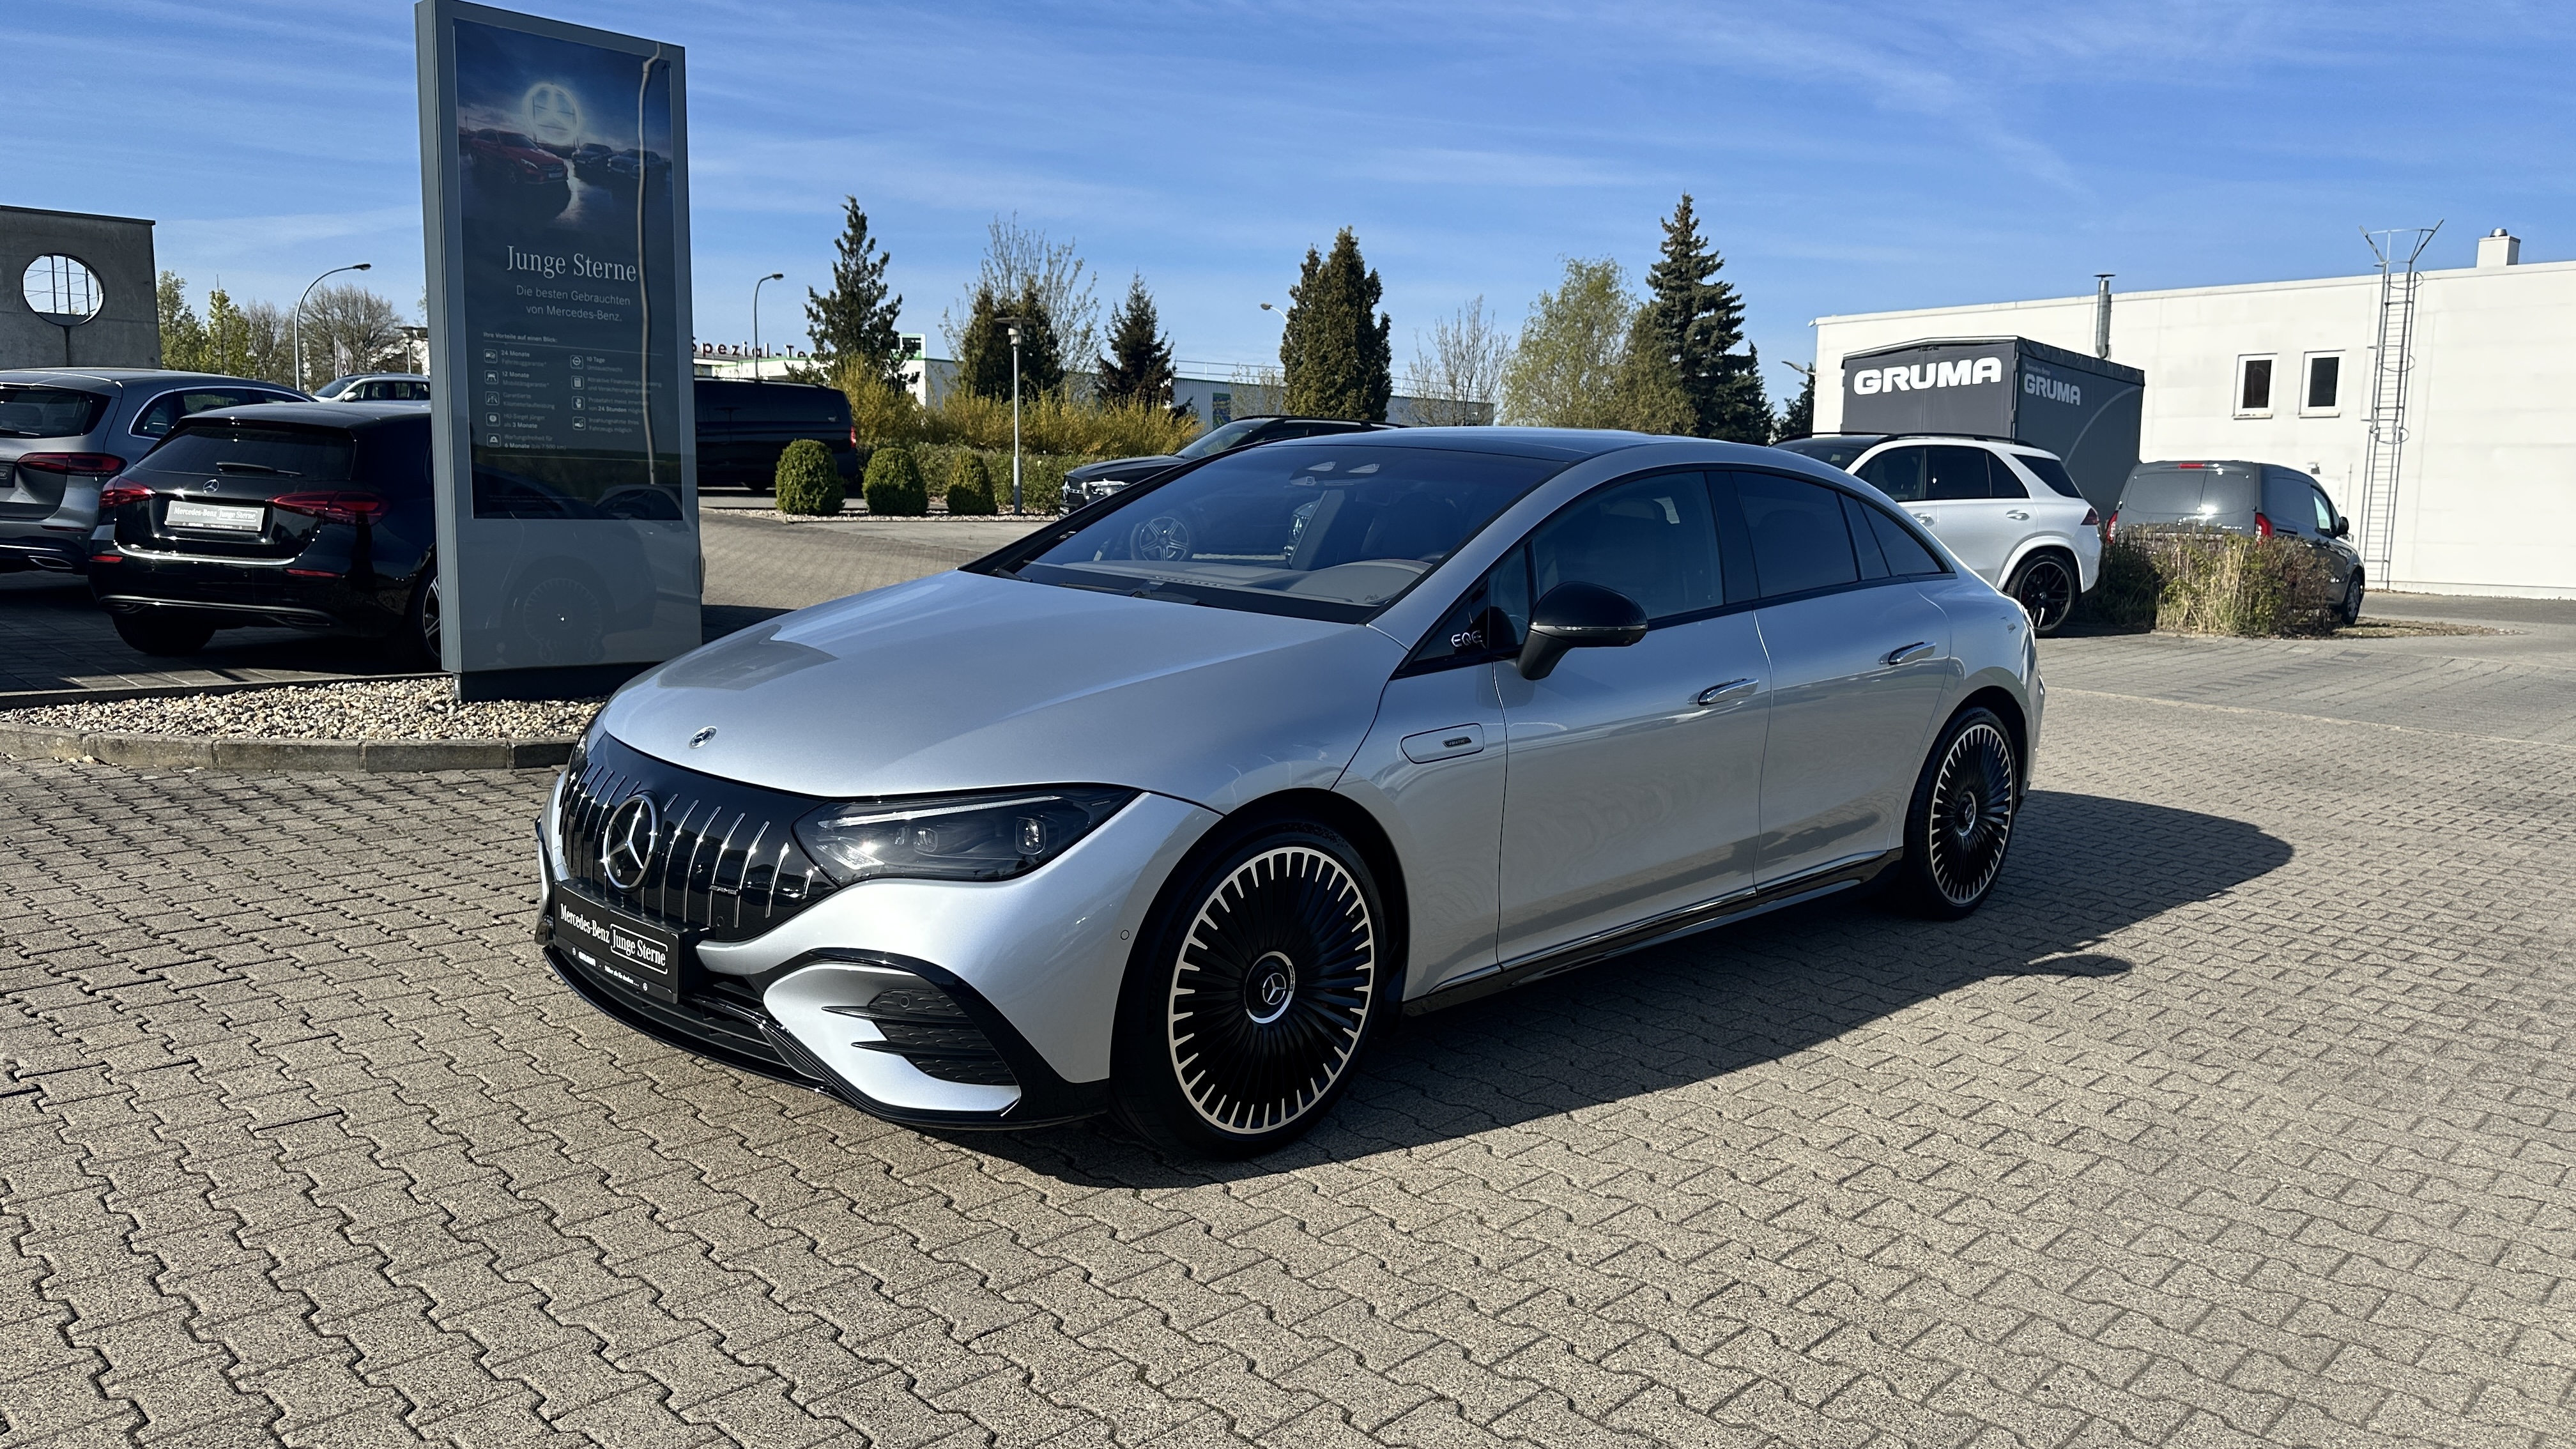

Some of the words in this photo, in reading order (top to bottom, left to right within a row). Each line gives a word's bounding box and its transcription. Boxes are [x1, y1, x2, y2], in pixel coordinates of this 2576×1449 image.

[507, 245, 566, 279] Junge
[573, 253, 637, 282] Sterne
[516, 285, 533, 296] Die
[535, 286, 568, 300] besten
[571, 290, 631, 305] Gebrauchten
[526, 305, 544, 314] von
[547, 305, 622, 322] Mercedes-Benz.
[1853, 356, 2002, 395] GRUMA
[2024, 373, 2081, 406] GRUMA
[174, 507, 217, 518] Mercedes-Benz
[218, 509, 236, 519] Junge
[236, 511, 256, 520] Sterne
[1450, 630, 1483, 647] EQE
[560, 903, 610, 944] Mercedes-Benz
[612, 929, 636, 956] Junge
[637, 939, 666, 967] Sterne
